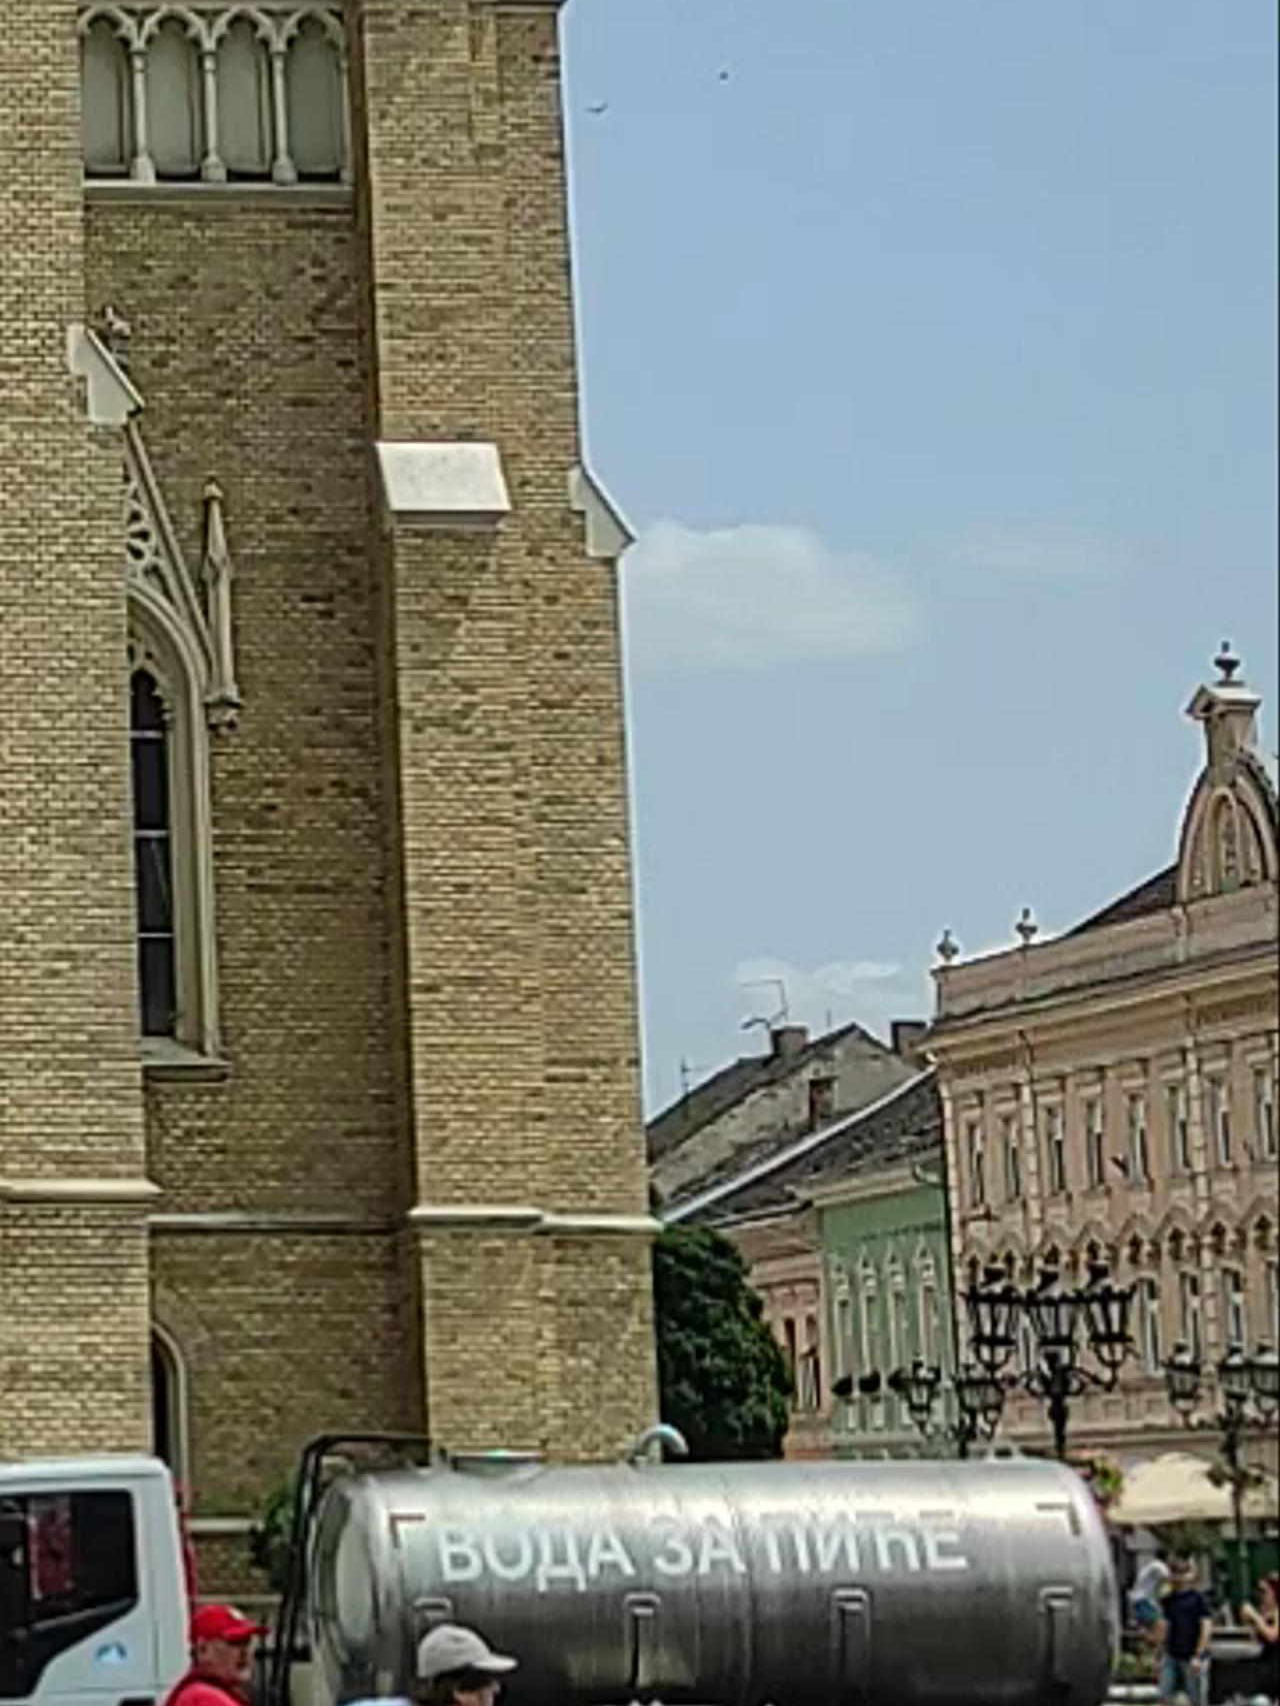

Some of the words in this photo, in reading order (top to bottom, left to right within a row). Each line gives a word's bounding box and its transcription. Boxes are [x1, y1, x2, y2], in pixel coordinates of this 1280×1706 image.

[438, 1524, 636, 1592] ВОДА
[653, 1516, 746, 1575] ЗА
[758, 1510, 970, 1574] ПИЋЕ
